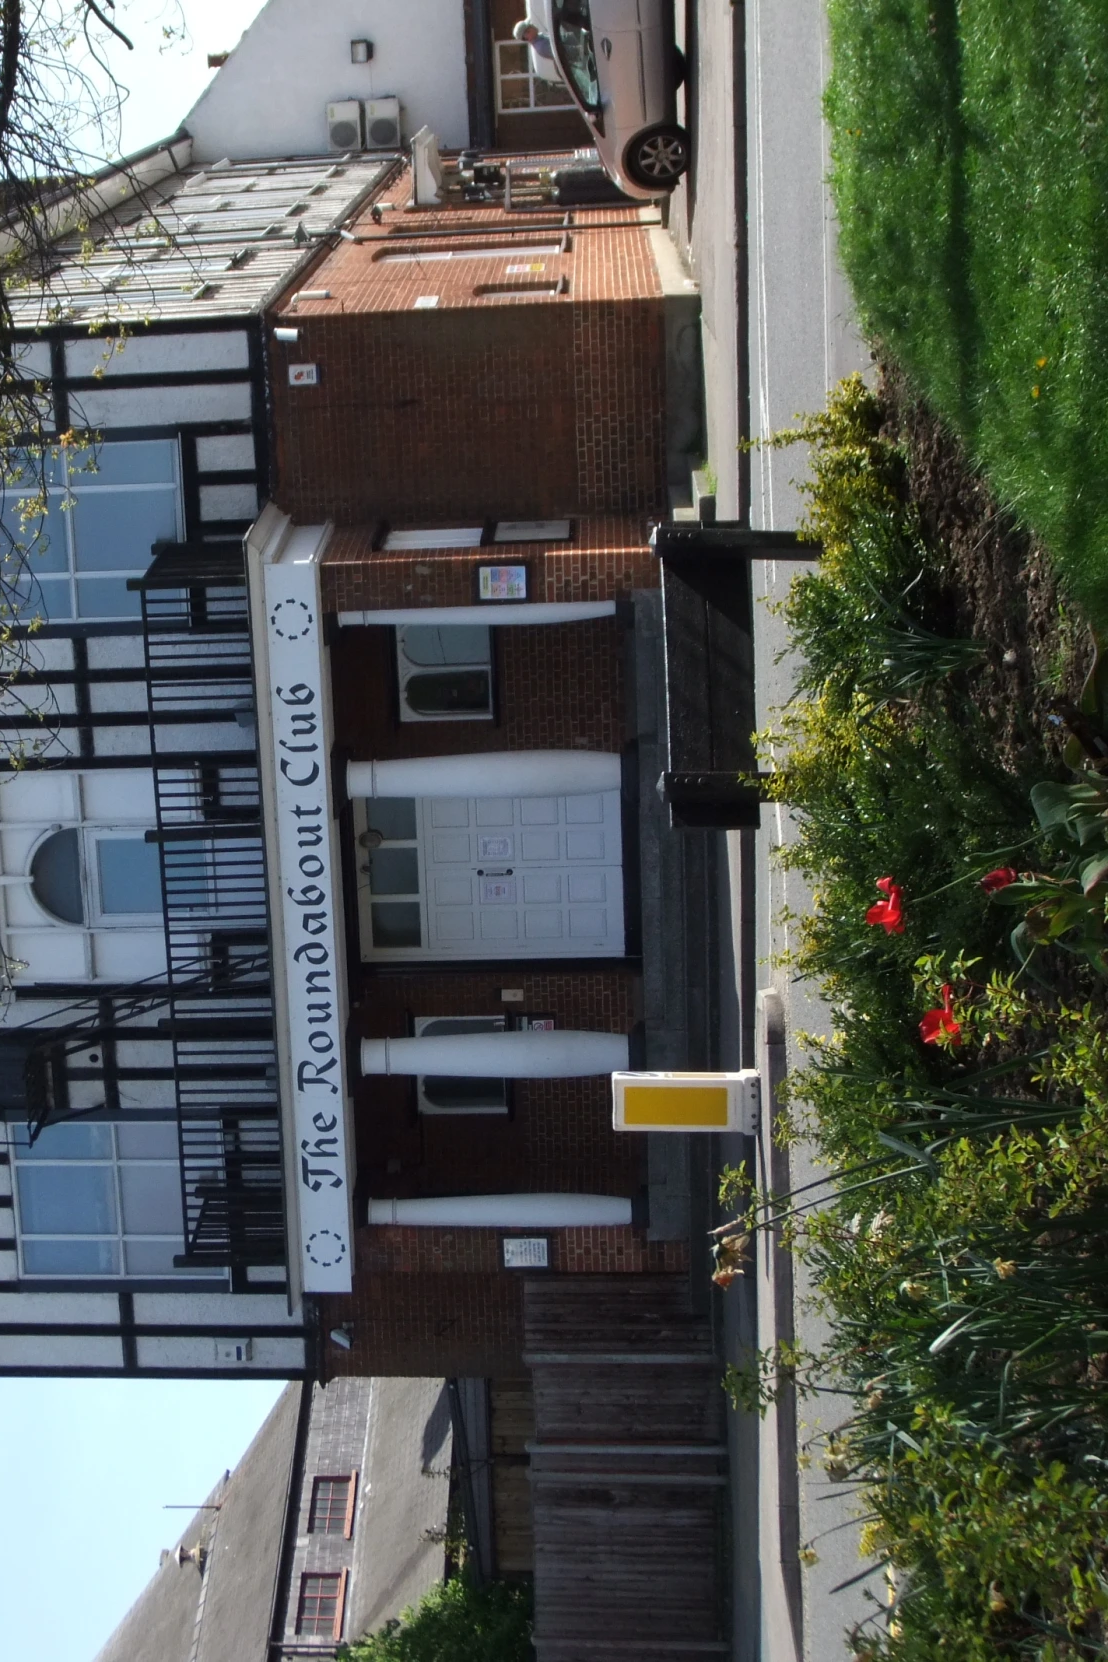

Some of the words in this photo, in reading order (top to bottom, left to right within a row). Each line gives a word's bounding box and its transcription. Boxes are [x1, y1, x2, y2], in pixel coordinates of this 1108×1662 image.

[276, 683, 320, 786] Club
[287, 805, 339, 1095] Roundabout
[300, 1112, 343, 1192] The
